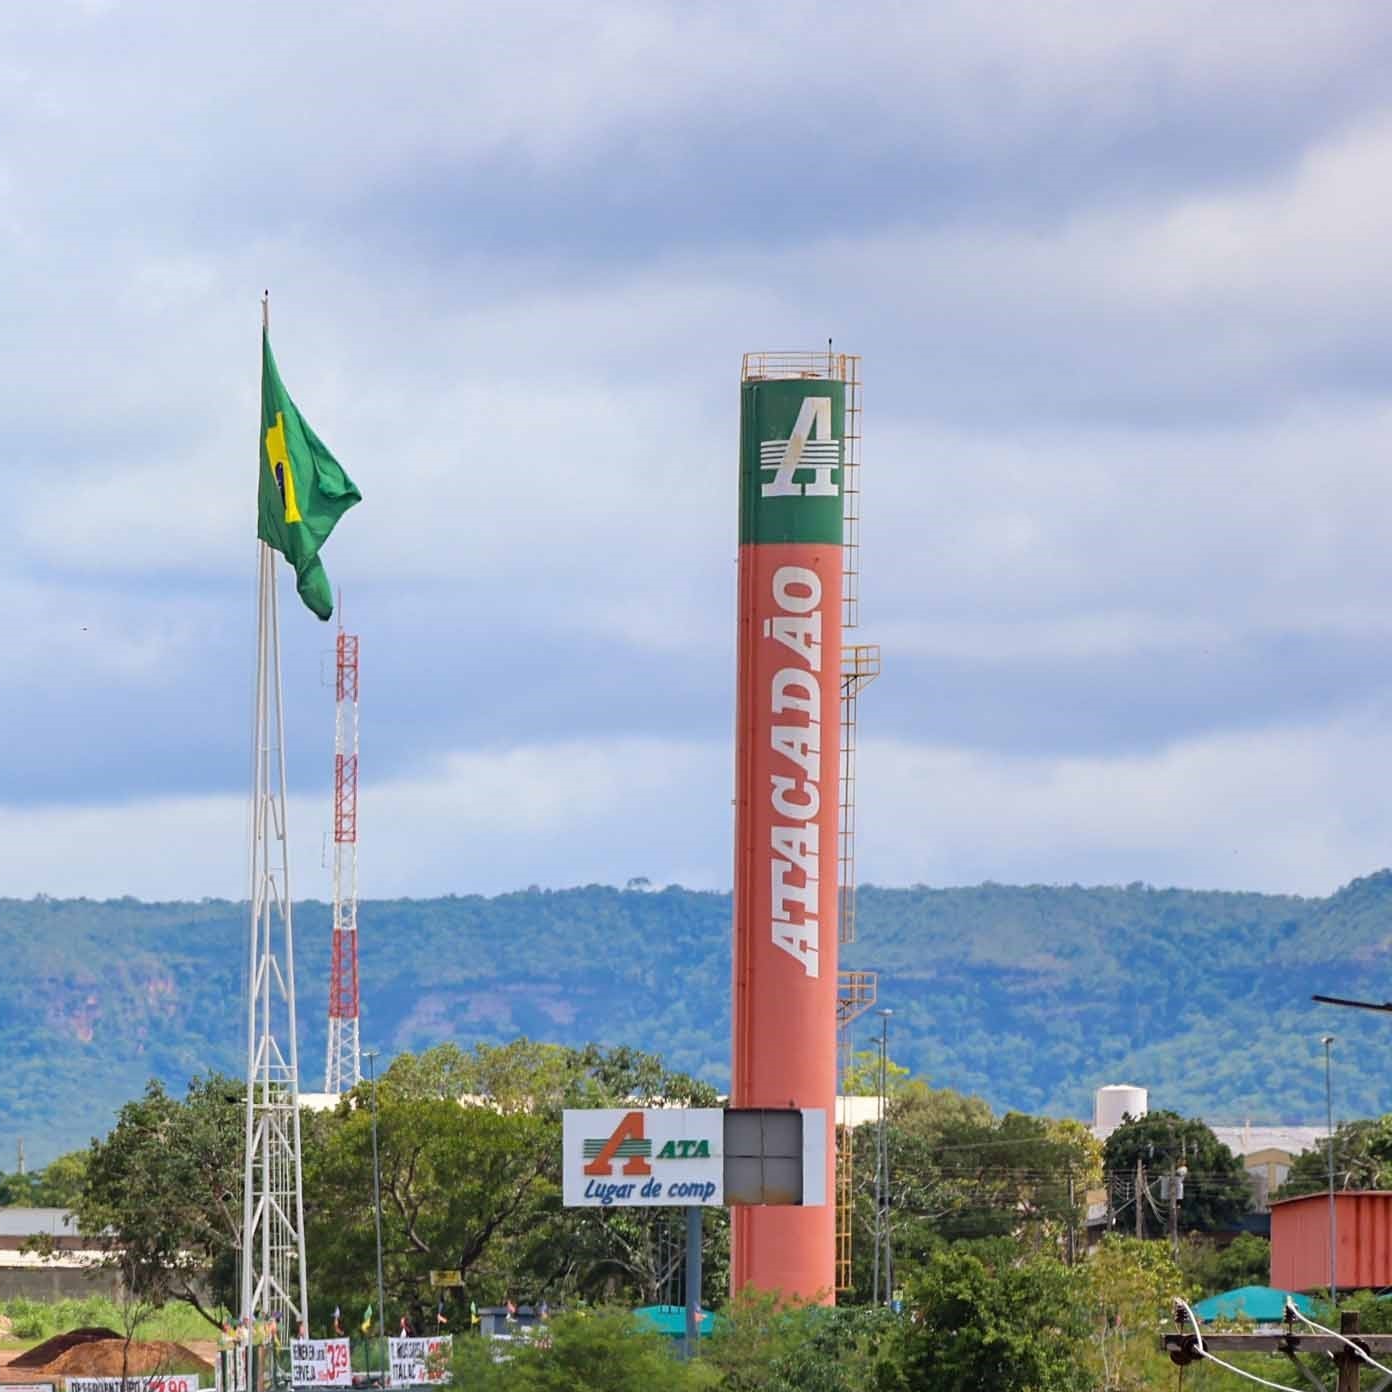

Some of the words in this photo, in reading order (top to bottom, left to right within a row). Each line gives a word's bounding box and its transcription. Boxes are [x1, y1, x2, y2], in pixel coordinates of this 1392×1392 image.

[763, 565, 823, 978] ATACADÃO
[583, 1179, 637, 1205] Lugar
[640, 1176, 661, 1198] de
[667, 1180, 716, 1202] comp
